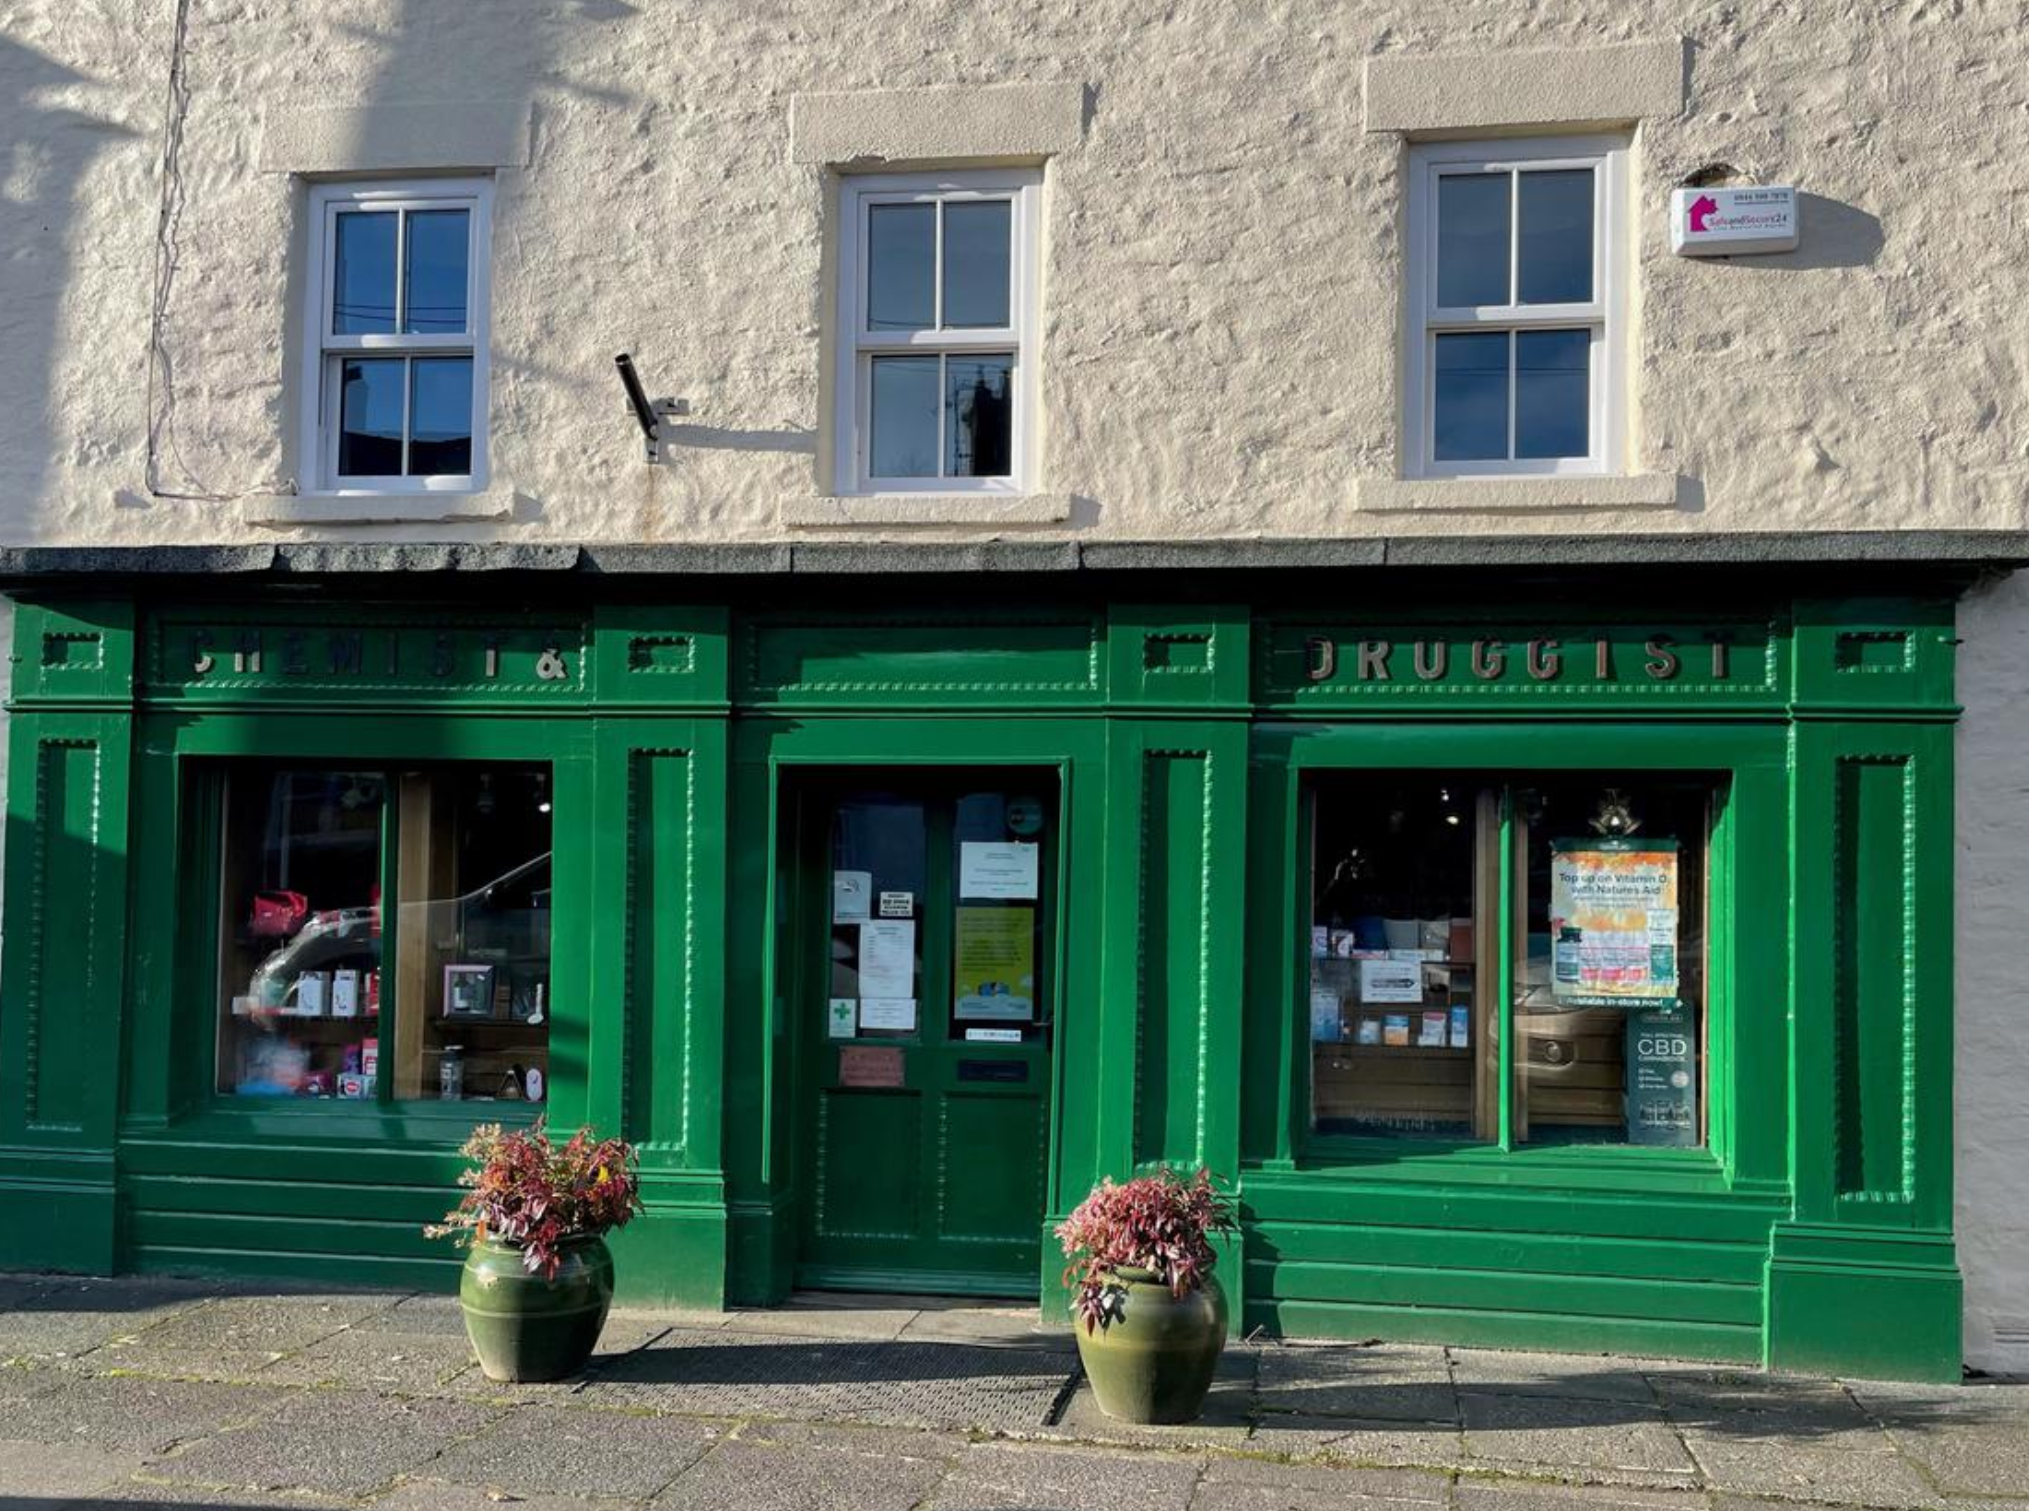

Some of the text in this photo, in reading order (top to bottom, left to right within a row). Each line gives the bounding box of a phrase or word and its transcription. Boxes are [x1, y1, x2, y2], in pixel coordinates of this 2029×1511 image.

[188, 629, 568, 680] CHEMIST &
[1305, 633, 1735, 681] DRUGGIST
[1559, 873, 1578, 884] Top
[1581, 875, 1595, 884] up
[1614, 873, 1656, 883] Vitamin
[1571, 885, 1661, 894] with Natures Aid
[1638, 1039, 1687, 1055] CBD
